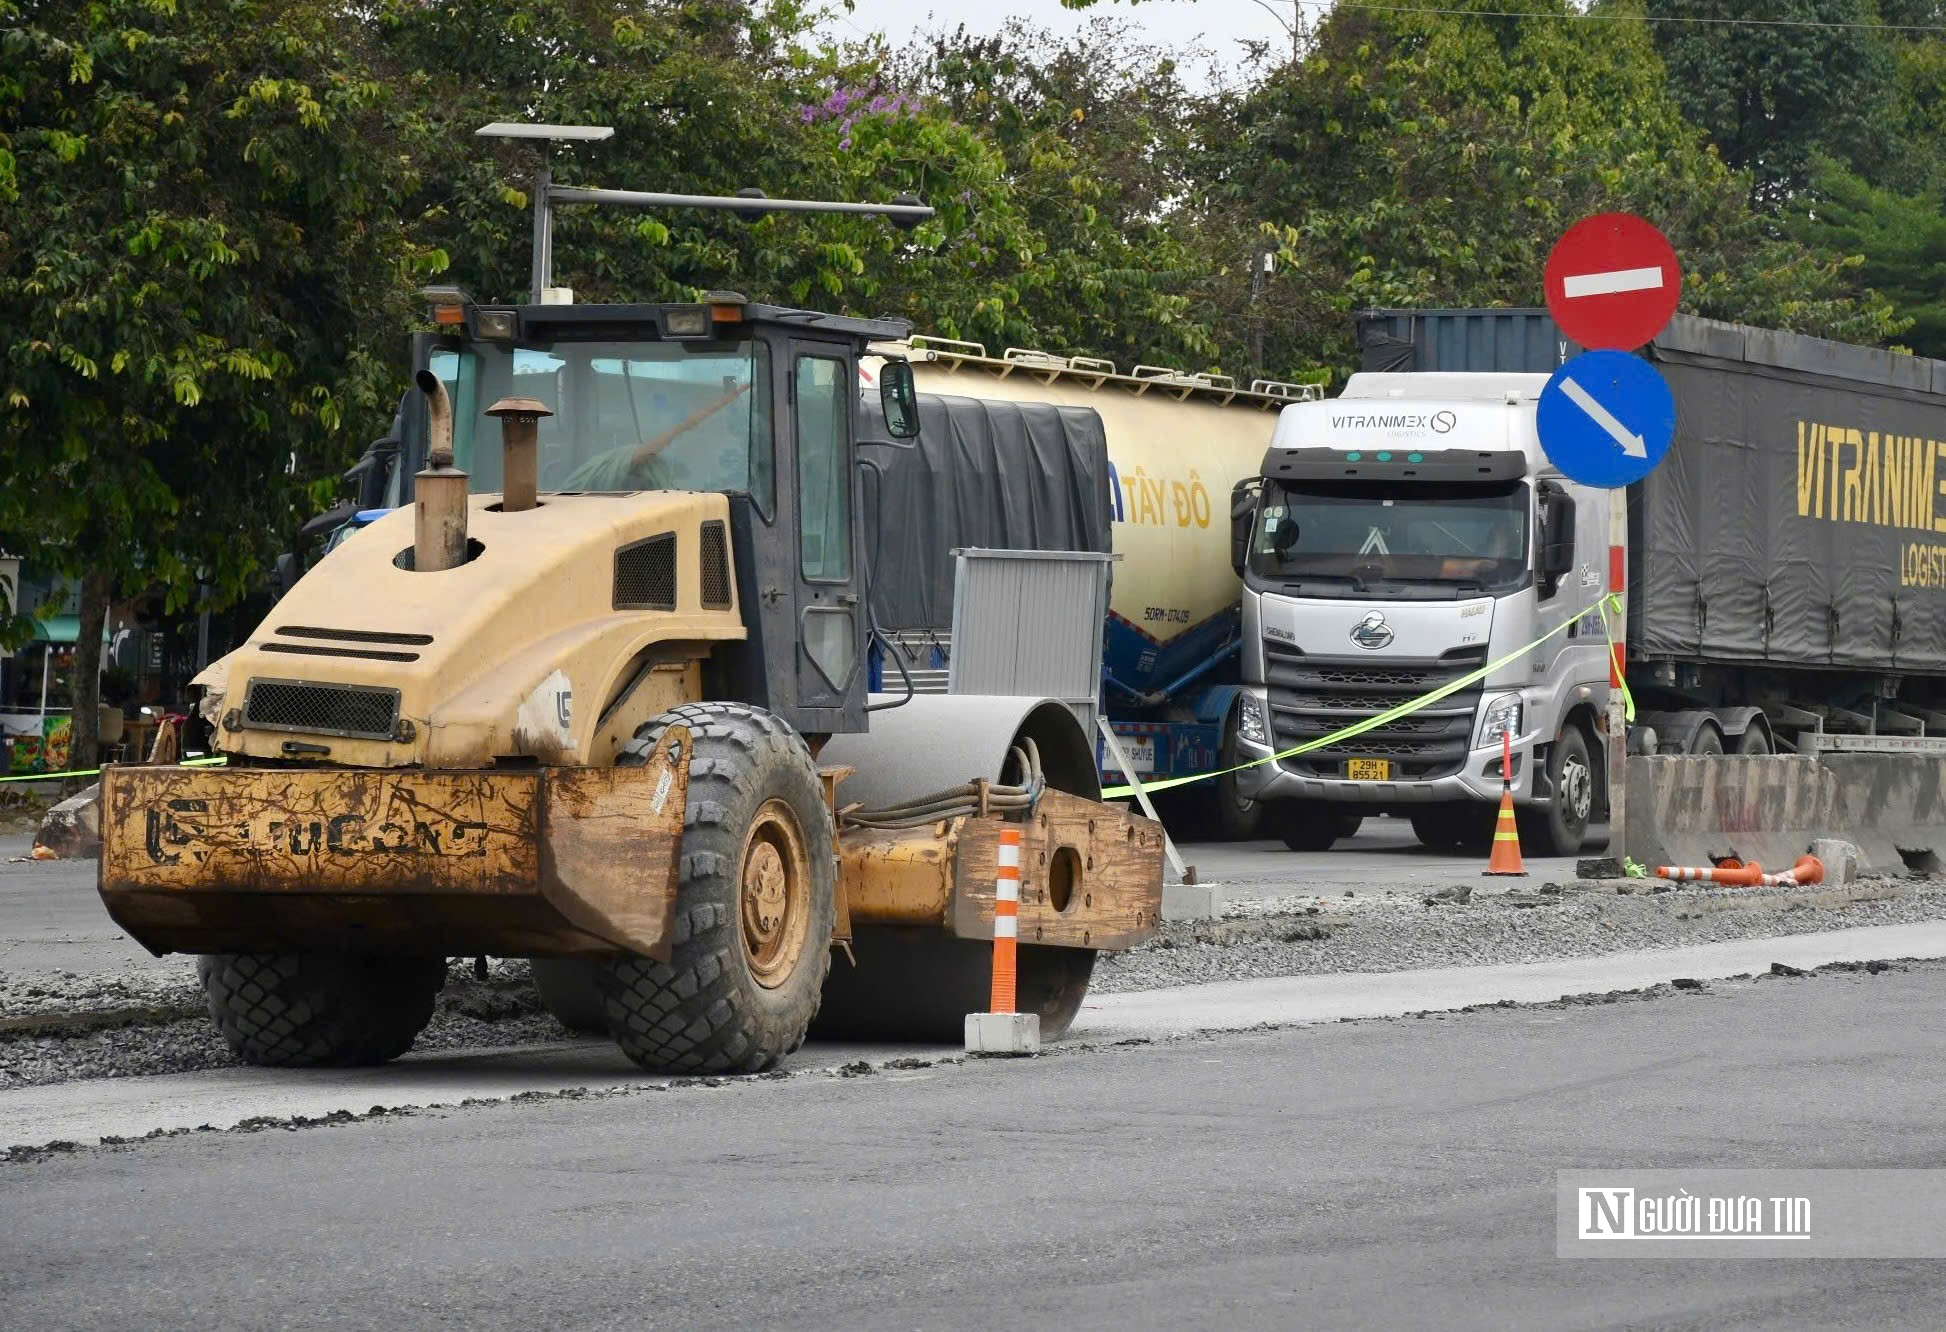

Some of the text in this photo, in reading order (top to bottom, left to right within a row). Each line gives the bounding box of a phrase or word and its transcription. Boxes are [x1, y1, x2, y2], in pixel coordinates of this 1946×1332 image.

[1332, 415, 1427, 429] VITRANIMEX
[1121, 465, 1166, 526] TÂY
[1171, 469, 1211, 529] ĐÔ
[1360, 760, 1377, 770] 29H
[1352, 770, 1384, 780] 855.21
